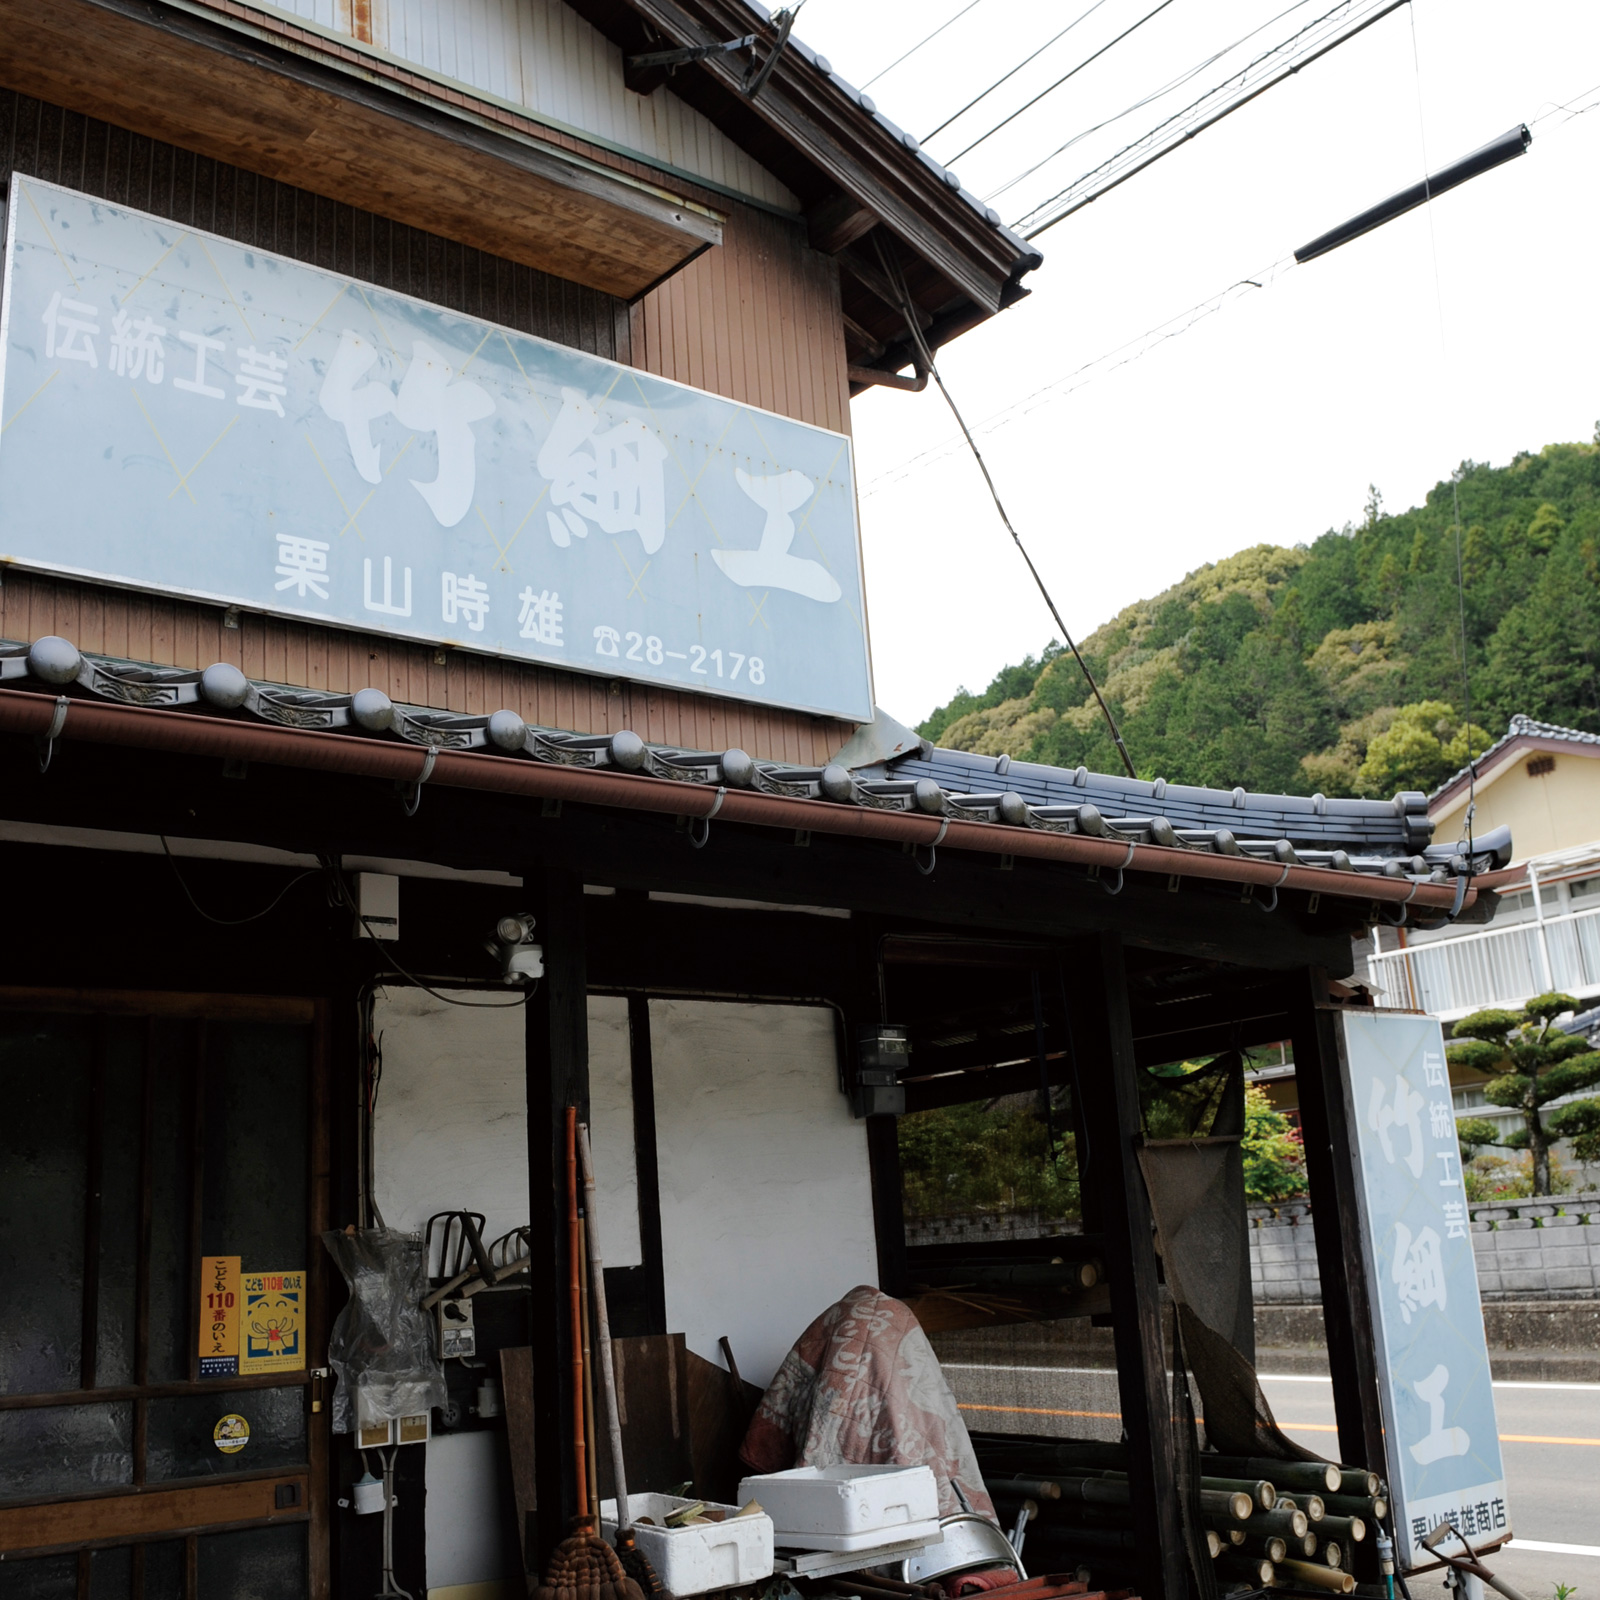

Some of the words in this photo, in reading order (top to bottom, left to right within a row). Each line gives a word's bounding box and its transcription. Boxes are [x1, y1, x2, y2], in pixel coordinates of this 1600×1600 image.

[42, 290, 288, 418] 伝統工芸
[319, 328, 842, 603] 竹細工
[274, 533, 563, 647] 栗山時雄
[625, 631, 766, 685] 28-2178
[1422, 1050, 1468, 1241] 伝統工芸
[206, 1260, 235, 1353] こども110番のいえ
[245, 1276, 302, 1291] こども110番のいえ
[1368, 1074, 1470, 1466] 竹細工
